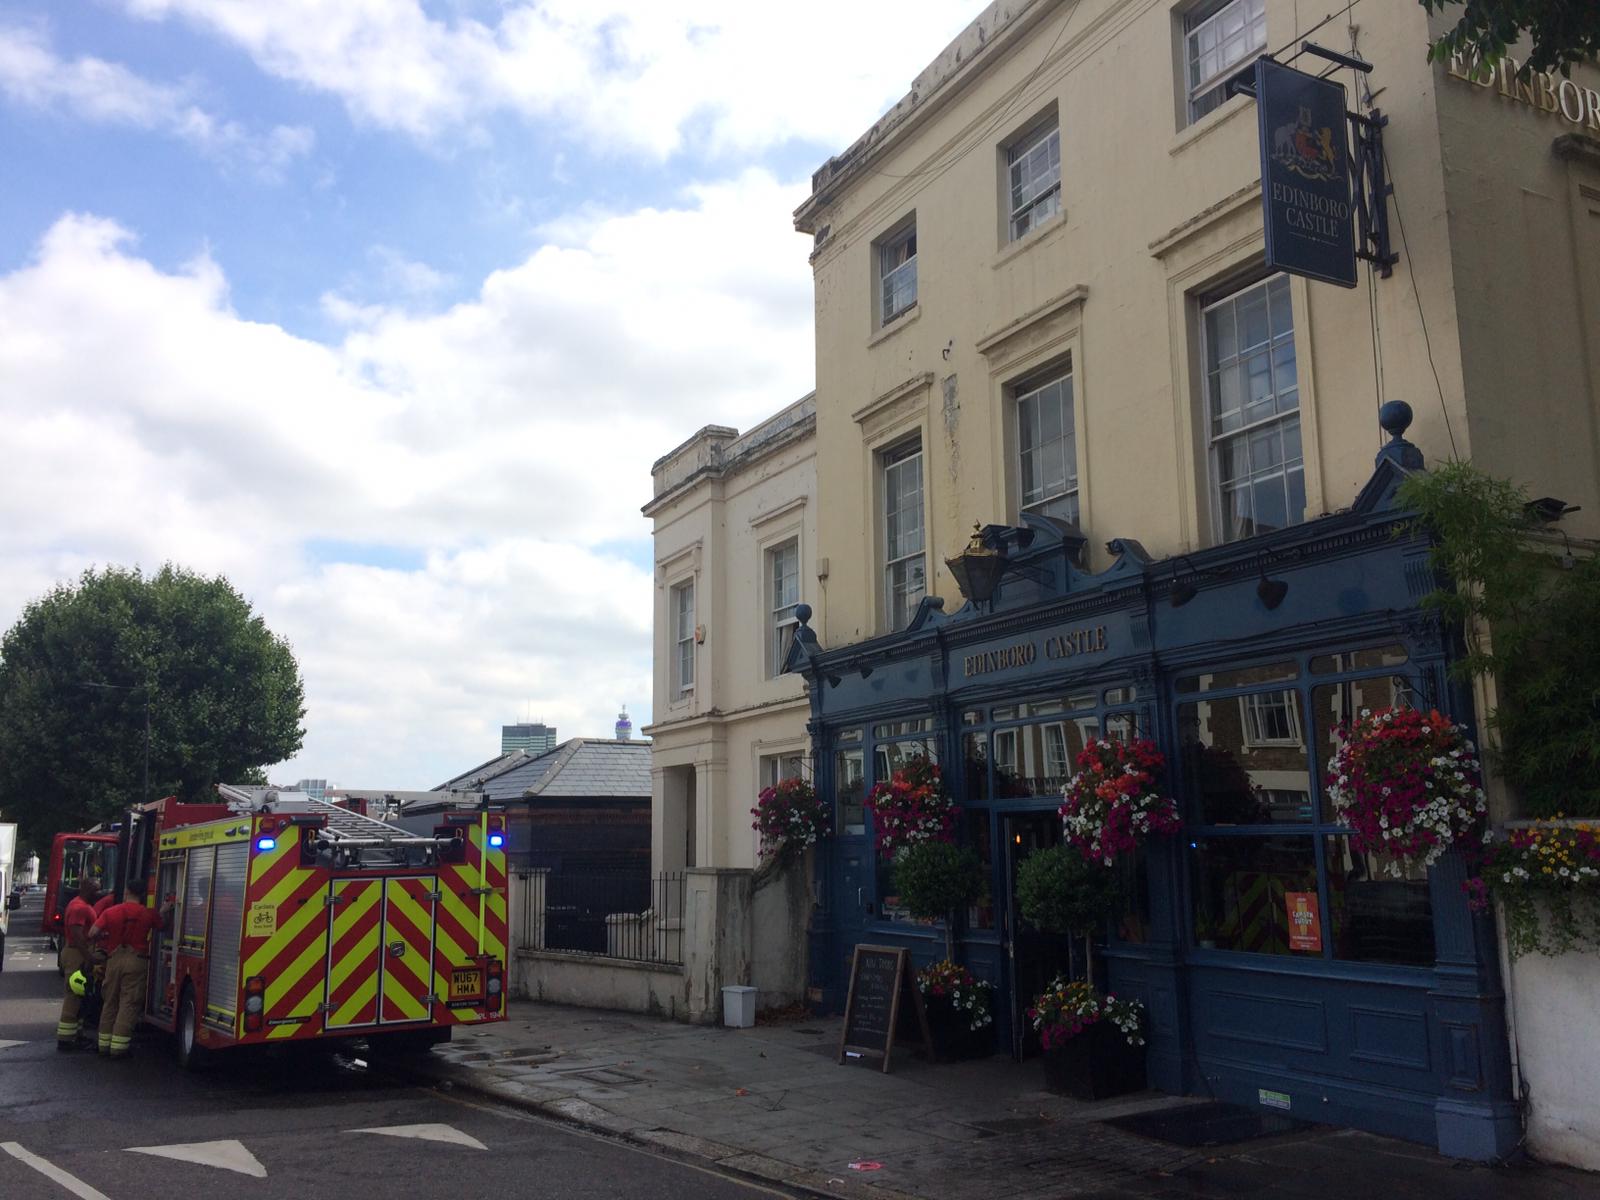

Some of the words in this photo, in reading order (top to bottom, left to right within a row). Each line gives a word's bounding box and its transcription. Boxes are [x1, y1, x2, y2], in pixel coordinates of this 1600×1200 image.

[1273, 182, 1348, 219] EDINBORO
[1286, 207, 1339, 238] CASTLE
[963, 641, 1035, 676] EDINBORO
[1043, 625, 1106, 659] CASTLE
[457, 983, 476, 994] HMA
